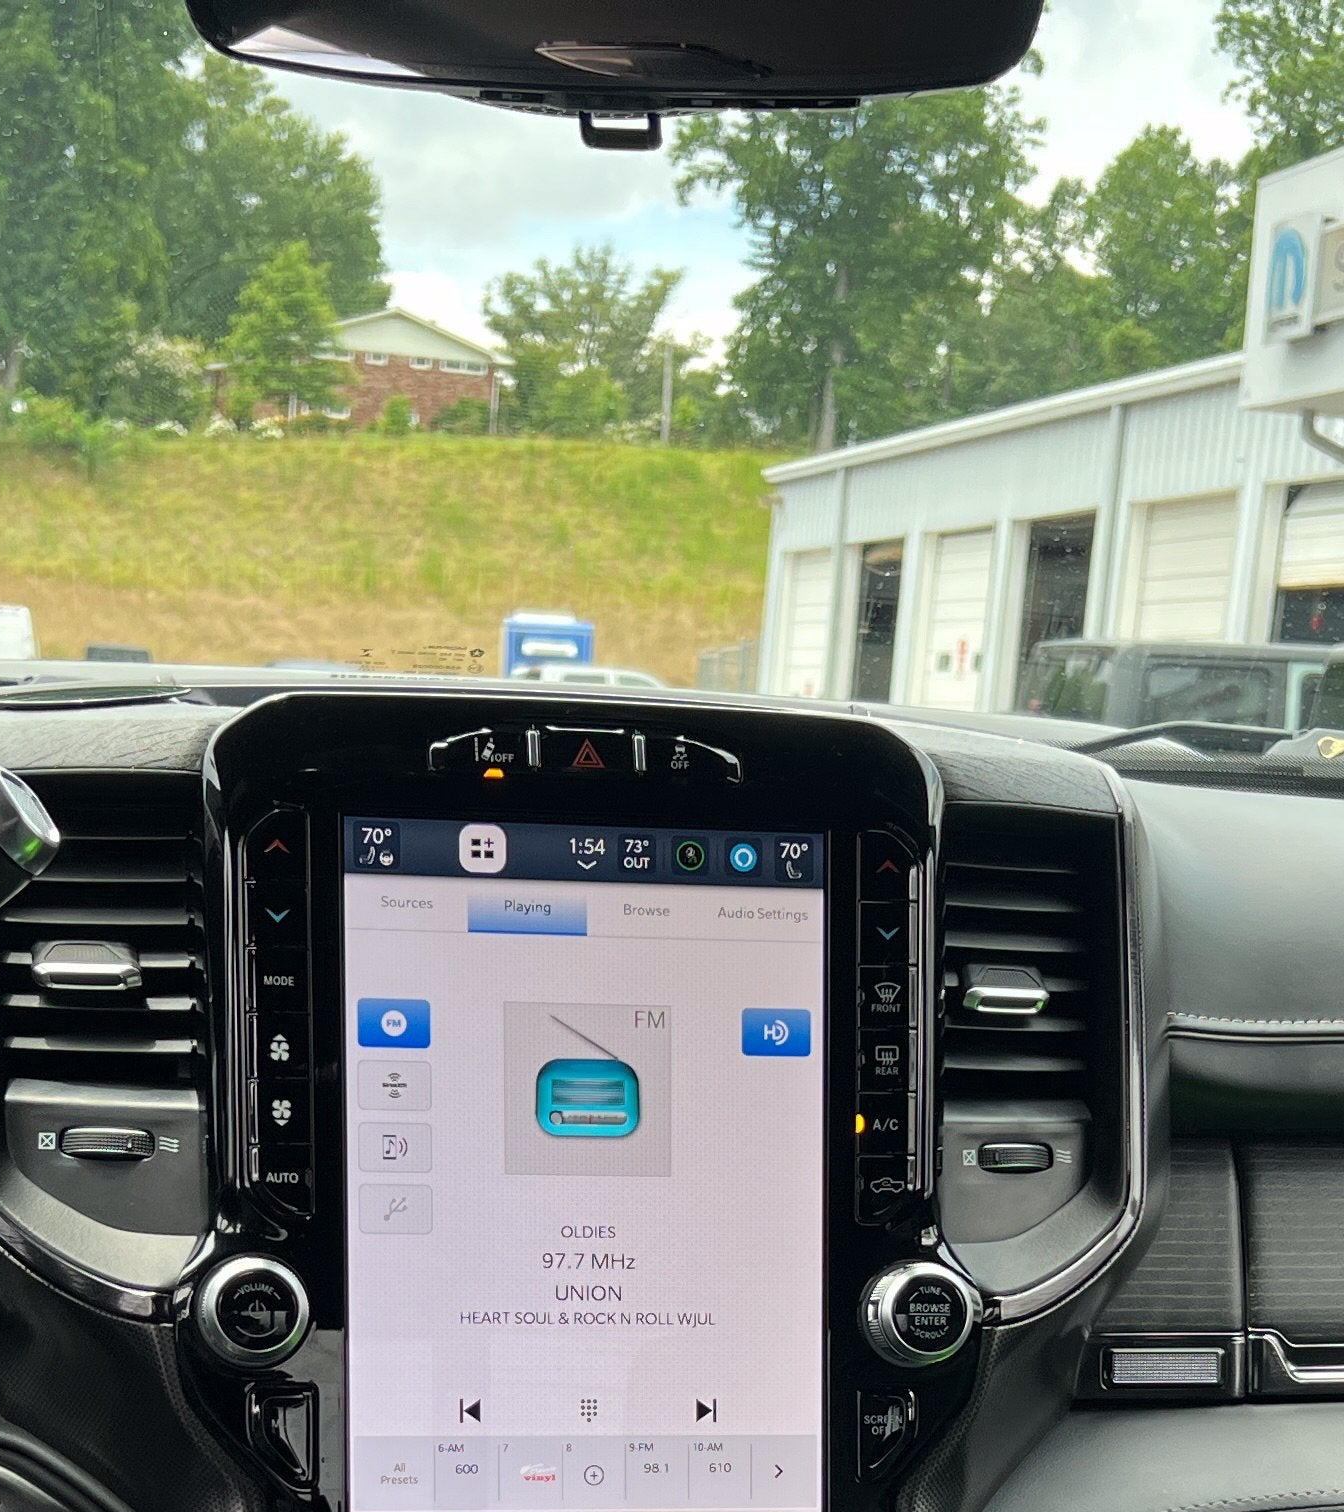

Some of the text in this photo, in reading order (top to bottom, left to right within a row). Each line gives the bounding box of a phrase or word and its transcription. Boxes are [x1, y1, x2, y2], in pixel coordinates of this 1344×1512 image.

[495, 752, 515, 763] OFF
[670, 760, 690, 770] OFF
[568, 838, 606, 856] 1:54
[623, 856, 650, 870] OUT
[380, 896, 434, 910] Sources
[503, 899, 552, 917] Playing
[623, 903, 671, 917] Browse
[717, 906, 809, 923] Audio Settings
[263, 975, 295, 986] MODE
[871, 1003, 902, 1013] FRONT
[386, 1019, 402, 1028] FM
[634, 1010, 666, 1029] FM
[875, 1066, 899, 1076] REAR
[872, 1118, 899, 1132] A/C
[266, 1172, 299, 1184] AUTO
[560, 1225, 616, 1239] OLDIES
[541, 1252, 636, 1270] 97.7 MHz
[238, 1283, 275, 1296] VOLUME
[555, 1285, 623, 1302] UNION
[918, 1285, 942, 1296] TUNE
[909, 1303, 951, 1314] BROWSE
[460, 1311, 716, 1328] HEART SOUL & ROCK N ROLL WJUL
[914, 1316, 947, 1326] ENTER
[913, 1329, 947, 1340] SCROLL
[863, 1415, 903, 1425] SCREEN
[438, 1443, 465, 1453] 6-AM
[393, 1463, 406, 1473] All
[455, 1463, 479, 1475] 600
[643, 1462, 669, 1474] 98.1
[709, 1462, 732, 1473] 610
[380, 1475, 419, 1485] Presets
